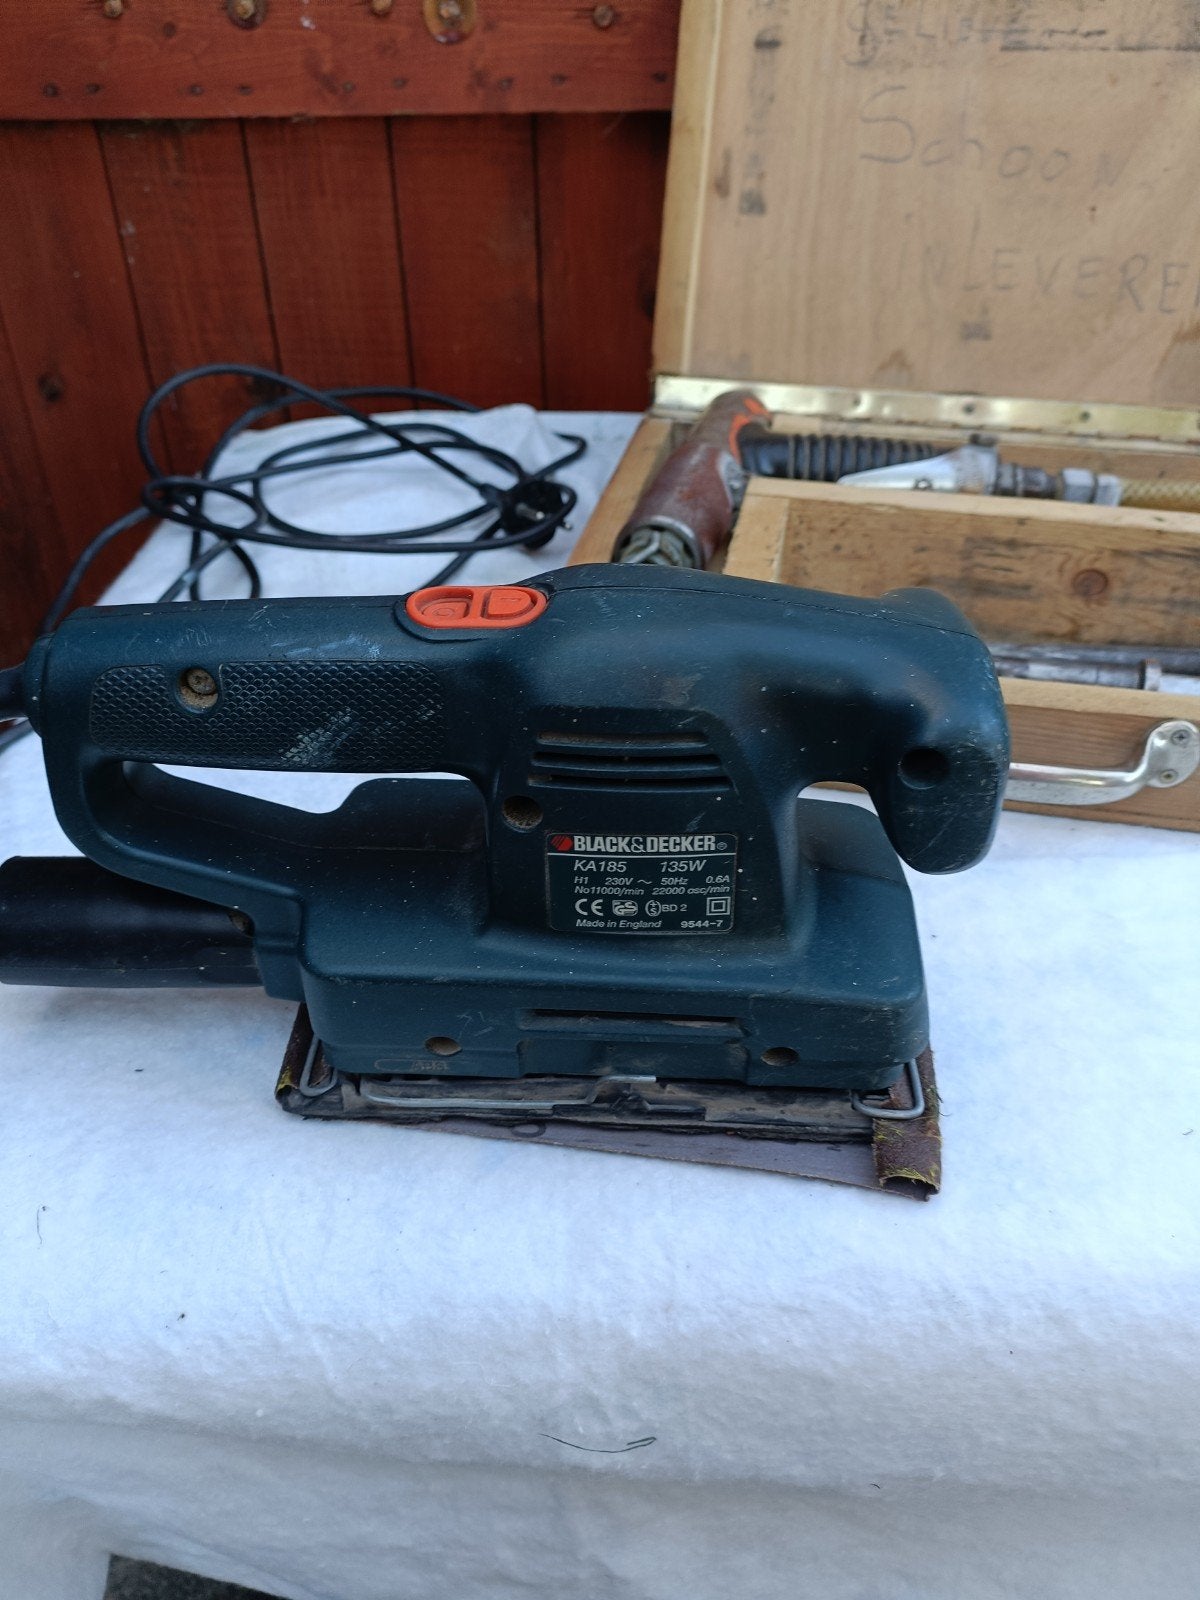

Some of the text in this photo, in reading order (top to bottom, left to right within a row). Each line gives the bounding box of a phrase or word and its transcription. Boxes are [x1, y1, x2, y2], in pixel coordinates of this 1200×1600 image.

[573, 859, 707, 873] KA185 135W
[604, 877, 634, 886] 230V
[660, 877, 689, 886] 50Hz
[705, 875, 730, 884] 0.6A
[652, 886, 686, 896] 22000
[687, 885, 731, 896] osc/min
[661, 903, 678, 912] BD
[680, 903, 688, 912] 2
[575, 918, 724, 930] Made in England 9544-7
